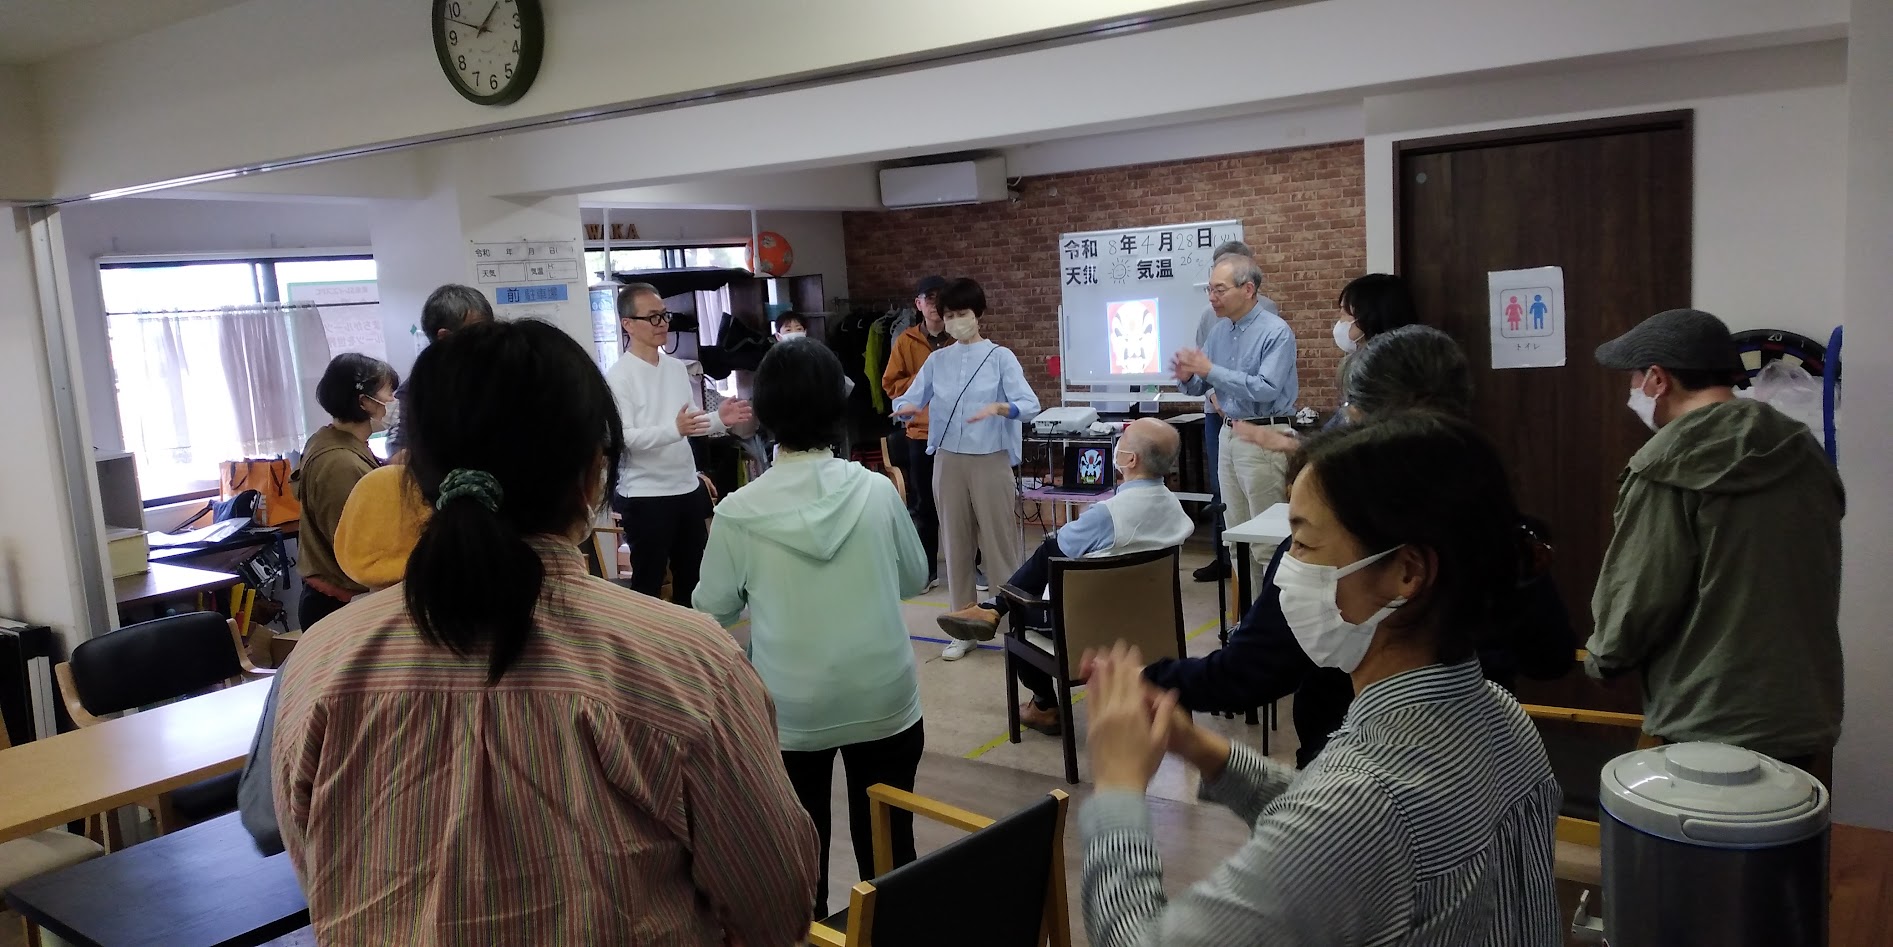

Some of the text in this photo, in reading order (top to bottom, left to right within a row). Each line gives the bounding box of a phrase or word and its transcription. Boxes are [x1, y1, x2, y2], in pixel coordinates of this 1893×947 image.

[448, 1, 461, 18] 10
[512, 12, 521, 30] 3
[449, 30, 458, 46] 9
[511, 40, 520, 55] 4
[458, 55, 467, 71] 8
[504, 63, 513, 79] 5
[472, 71, 480, 87] 7
[489, 74, 498, 90] 6
[1136, 258, 1174, 281] 気温
[1767, 332, 1783, 342] 20
[1516, 342, 1541, 352] トイレ
